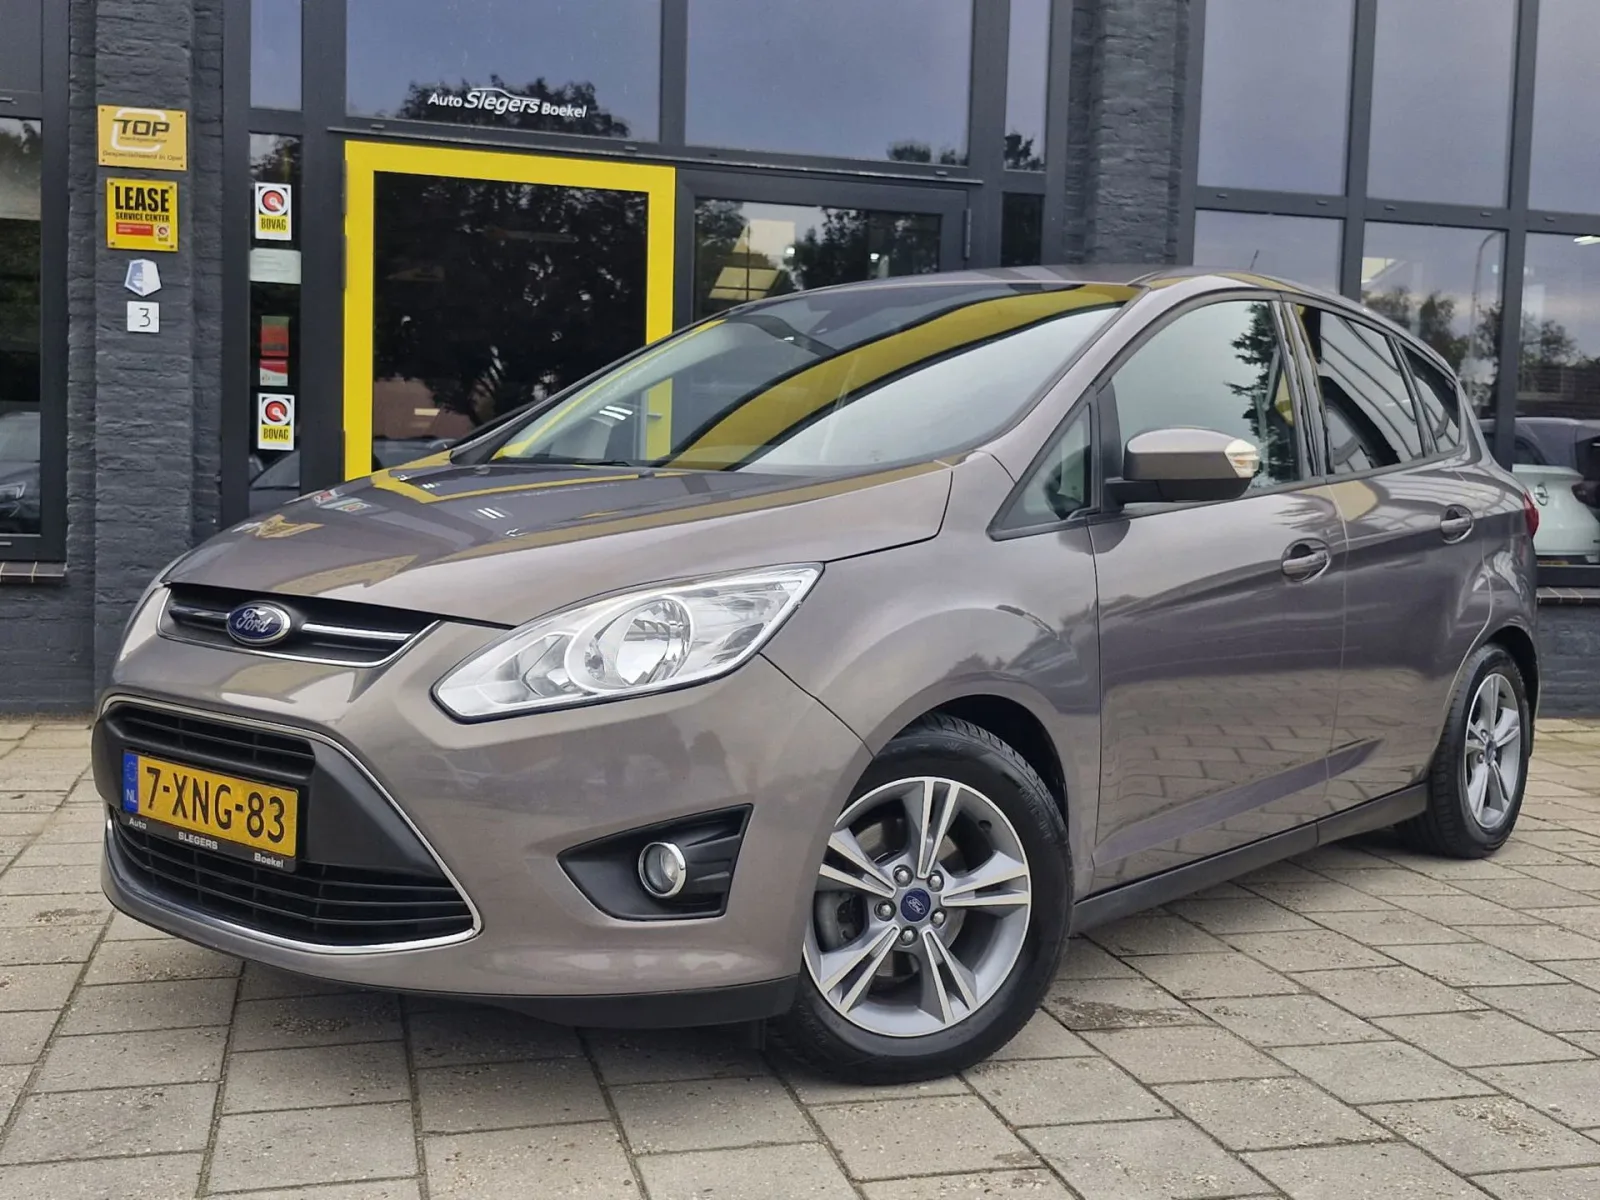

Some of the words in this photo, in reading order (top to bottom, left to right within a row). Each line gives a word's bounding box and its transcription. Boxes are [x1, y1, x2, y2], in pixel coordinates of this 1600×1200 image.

[428, 93, 463, 107] Auto
[464, 91, 540, 115] Slegers
[541, 102, 587, 118] Boekel
[113, 119, 170, 137] TOP
[115, 186, 170, 213] LEASE
[115, 212, 143, 221] SERVICE
[145, 213, 170, 222] CENTER
[261, 217, 287, 231] BOVAG
[139, 307, 151, 328] 3
[263, 428, 289, 440] BOVAG
[235, 608, 273, 633] Ford
[126, 788, 137, 803] NL
[146, 766, 285, 844] 7-XNG-83
[128, 817, 147, 830] Auto
[178, 831, 219, 850] SLEGERS
[254, 852, 285, 868] Boekel
